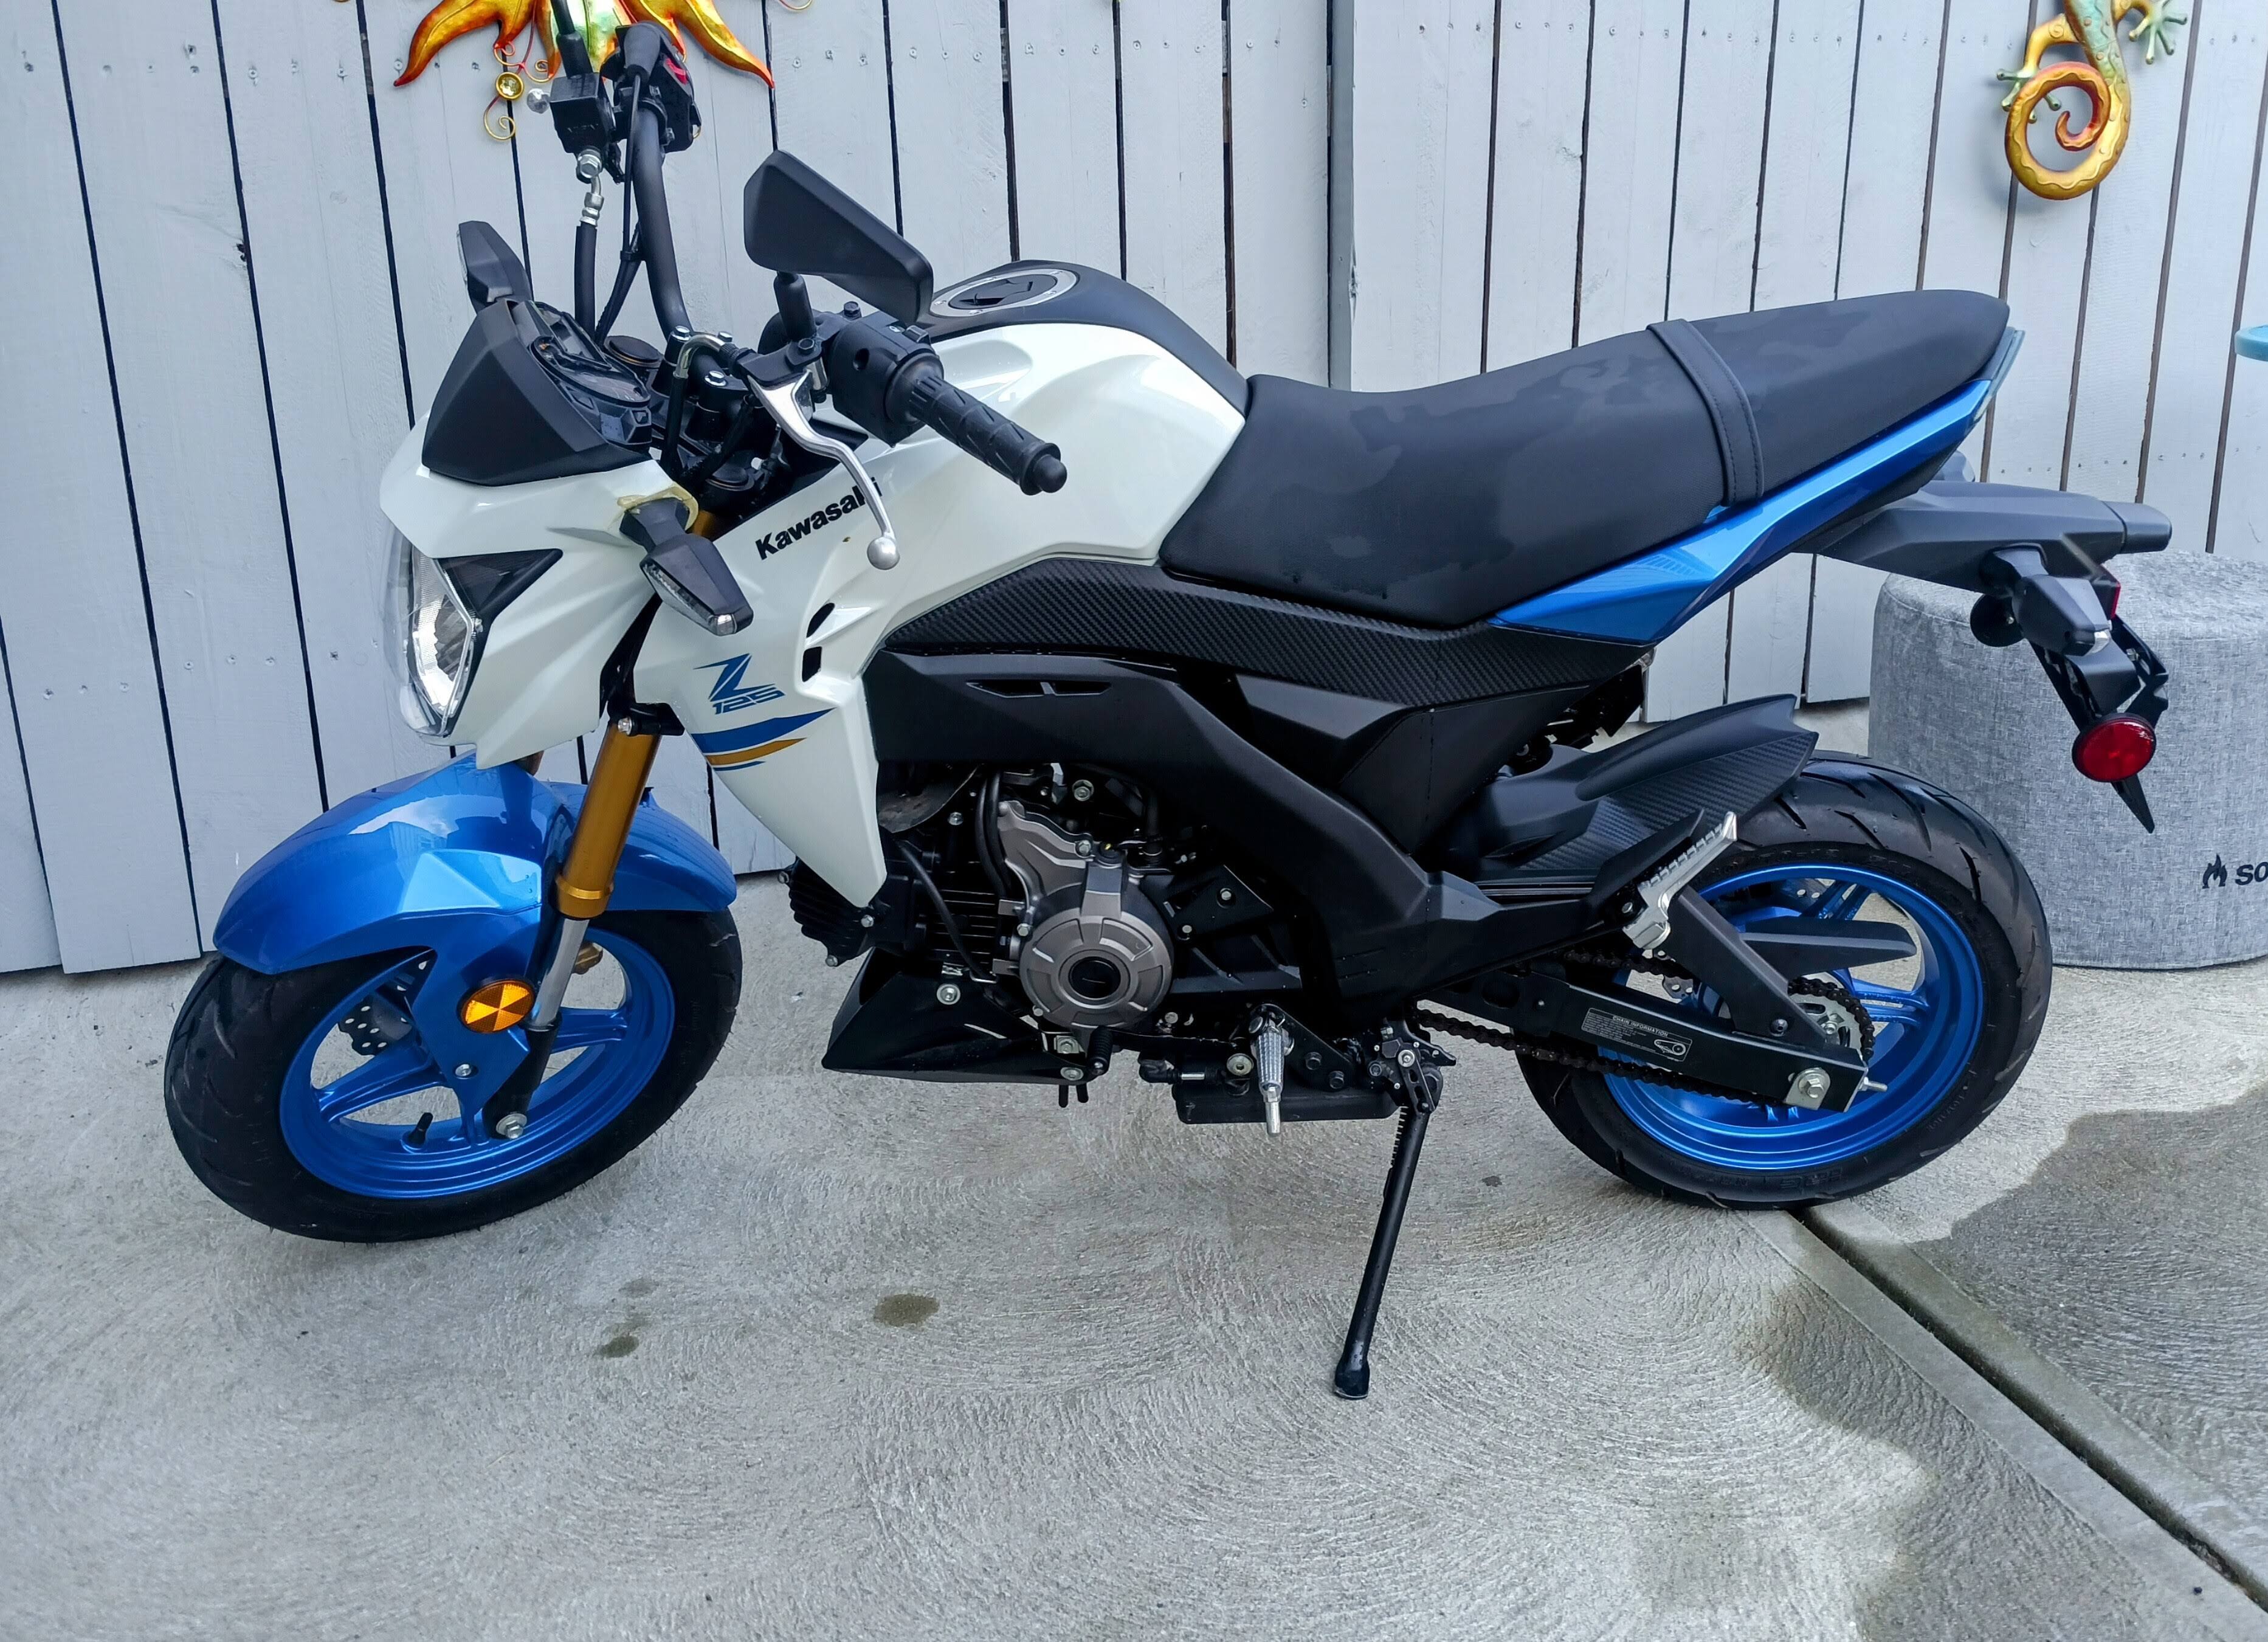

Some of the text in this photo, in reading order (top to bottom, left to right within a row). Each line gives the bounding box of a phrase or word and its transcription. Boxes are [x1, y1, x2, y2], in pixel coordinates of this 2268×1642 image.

[693, 653, 776, 702] Z
[712, 687, 786, 715] 125
[1613, 1016, 1669, 1037] CHAIN INFORMATION
